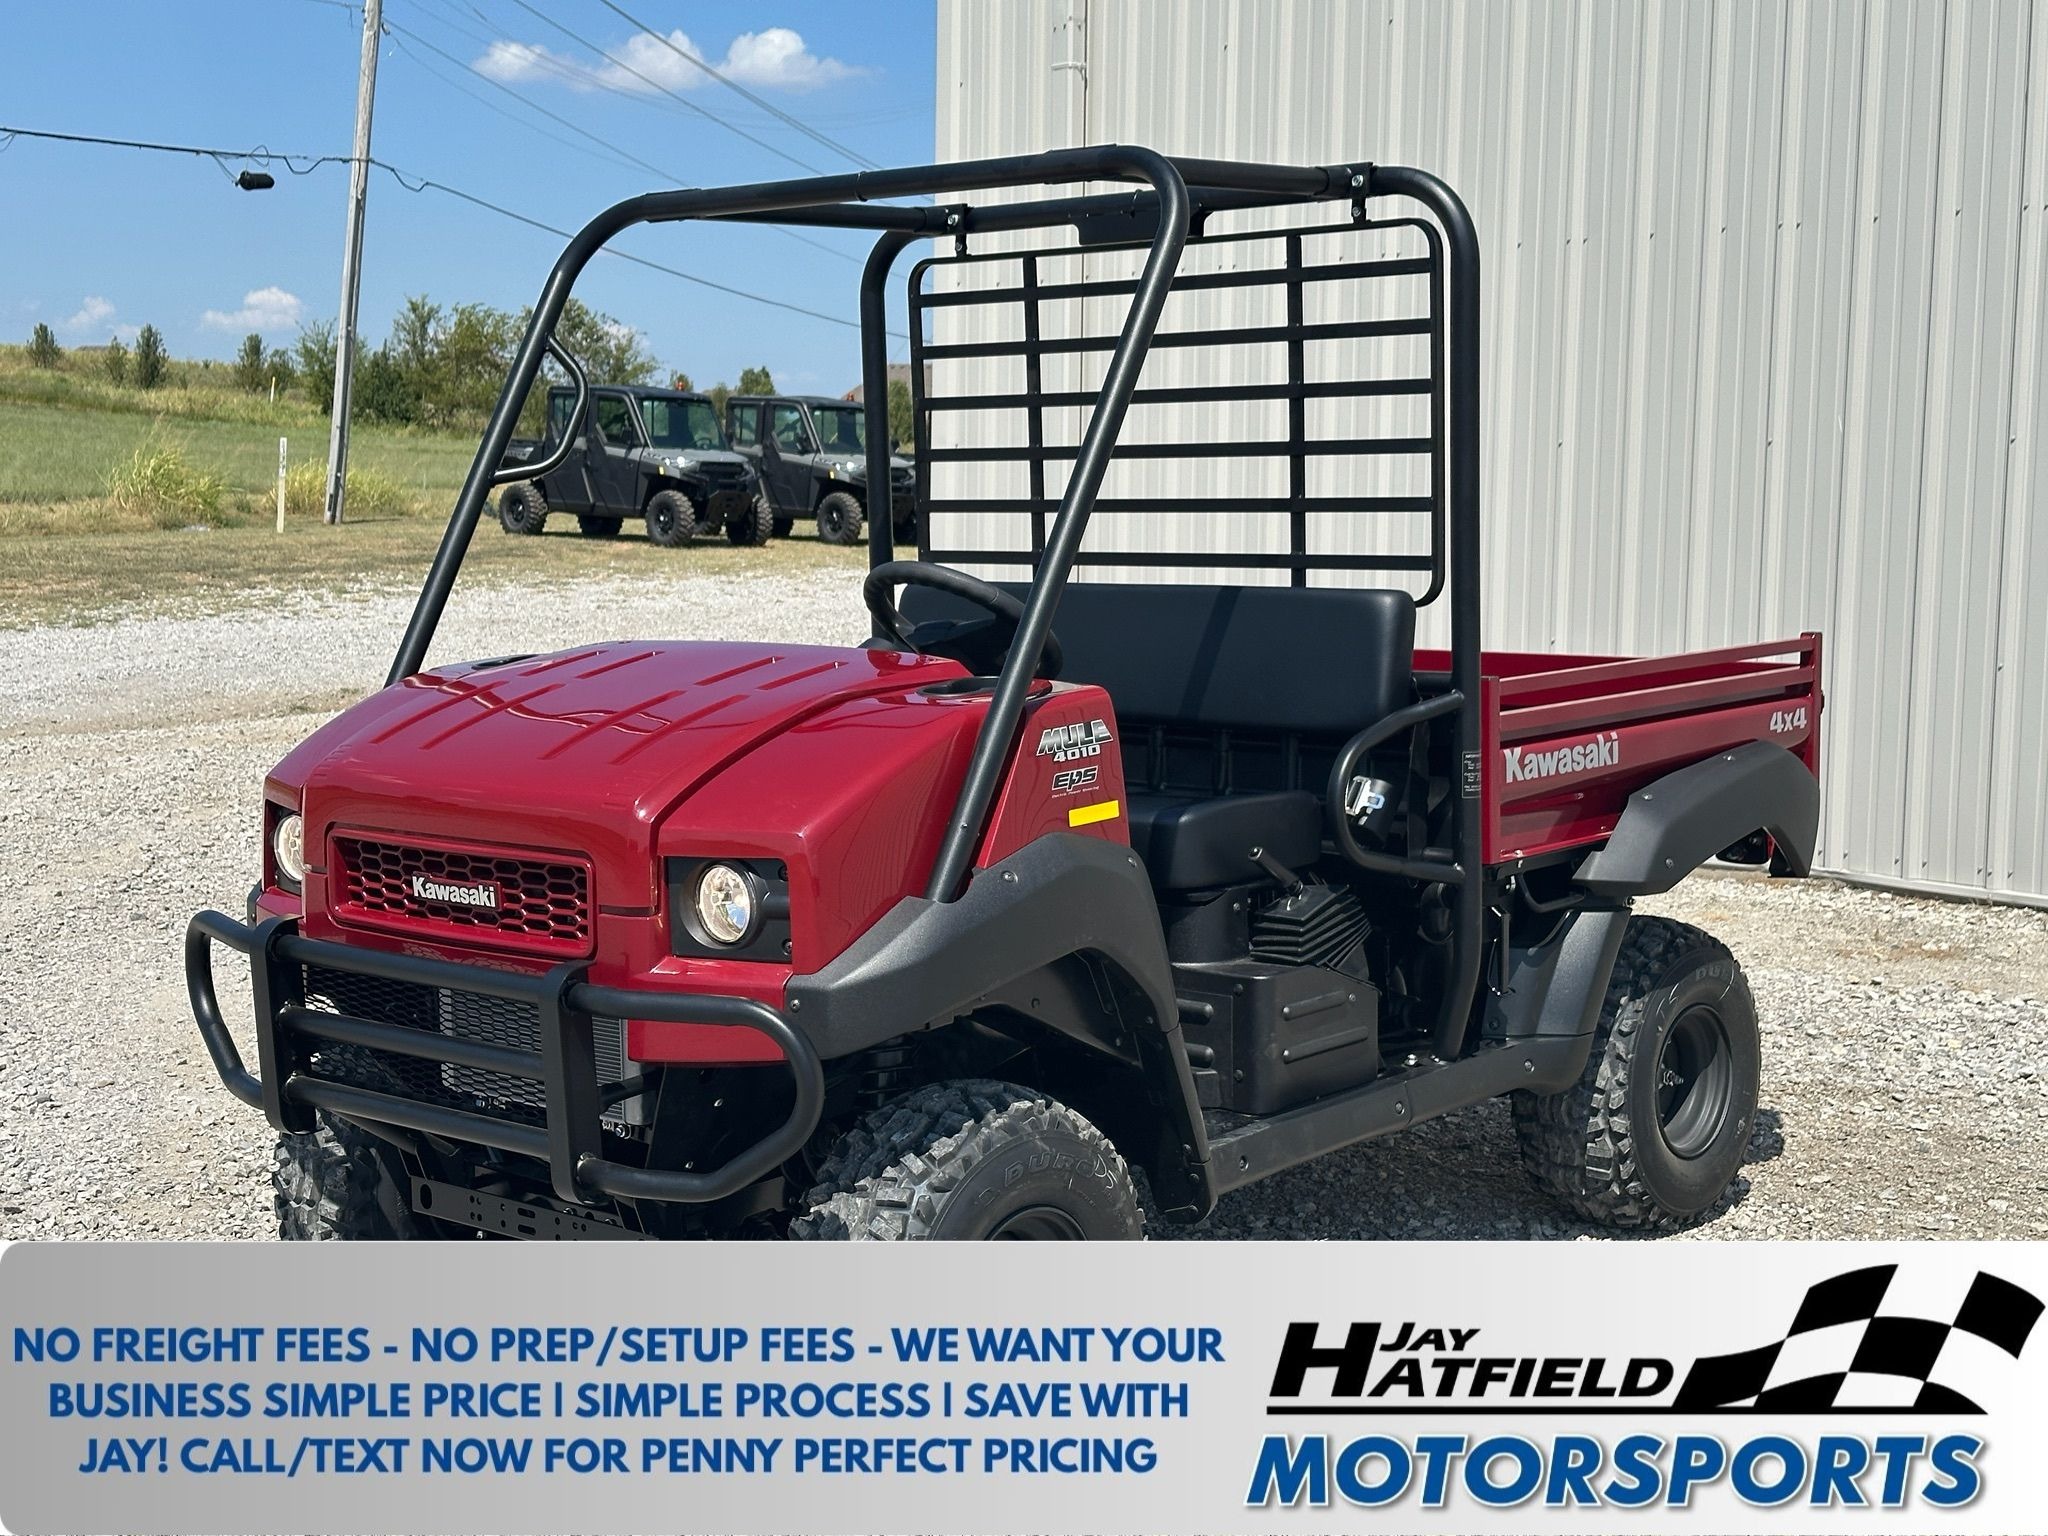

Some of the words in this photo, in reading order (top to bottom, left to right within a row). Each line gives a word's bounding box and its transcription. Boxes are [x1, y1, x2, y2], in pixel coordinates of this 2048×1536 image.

[1769, 706, 1808, 733] 4x4
[1036, 719, 1114, 756] MULE
[1053, 744, 1101, 763] 4010
[1503, 731, 1619, 783] Kawasaki
[412, 876, 496, 907] Kawasaki
